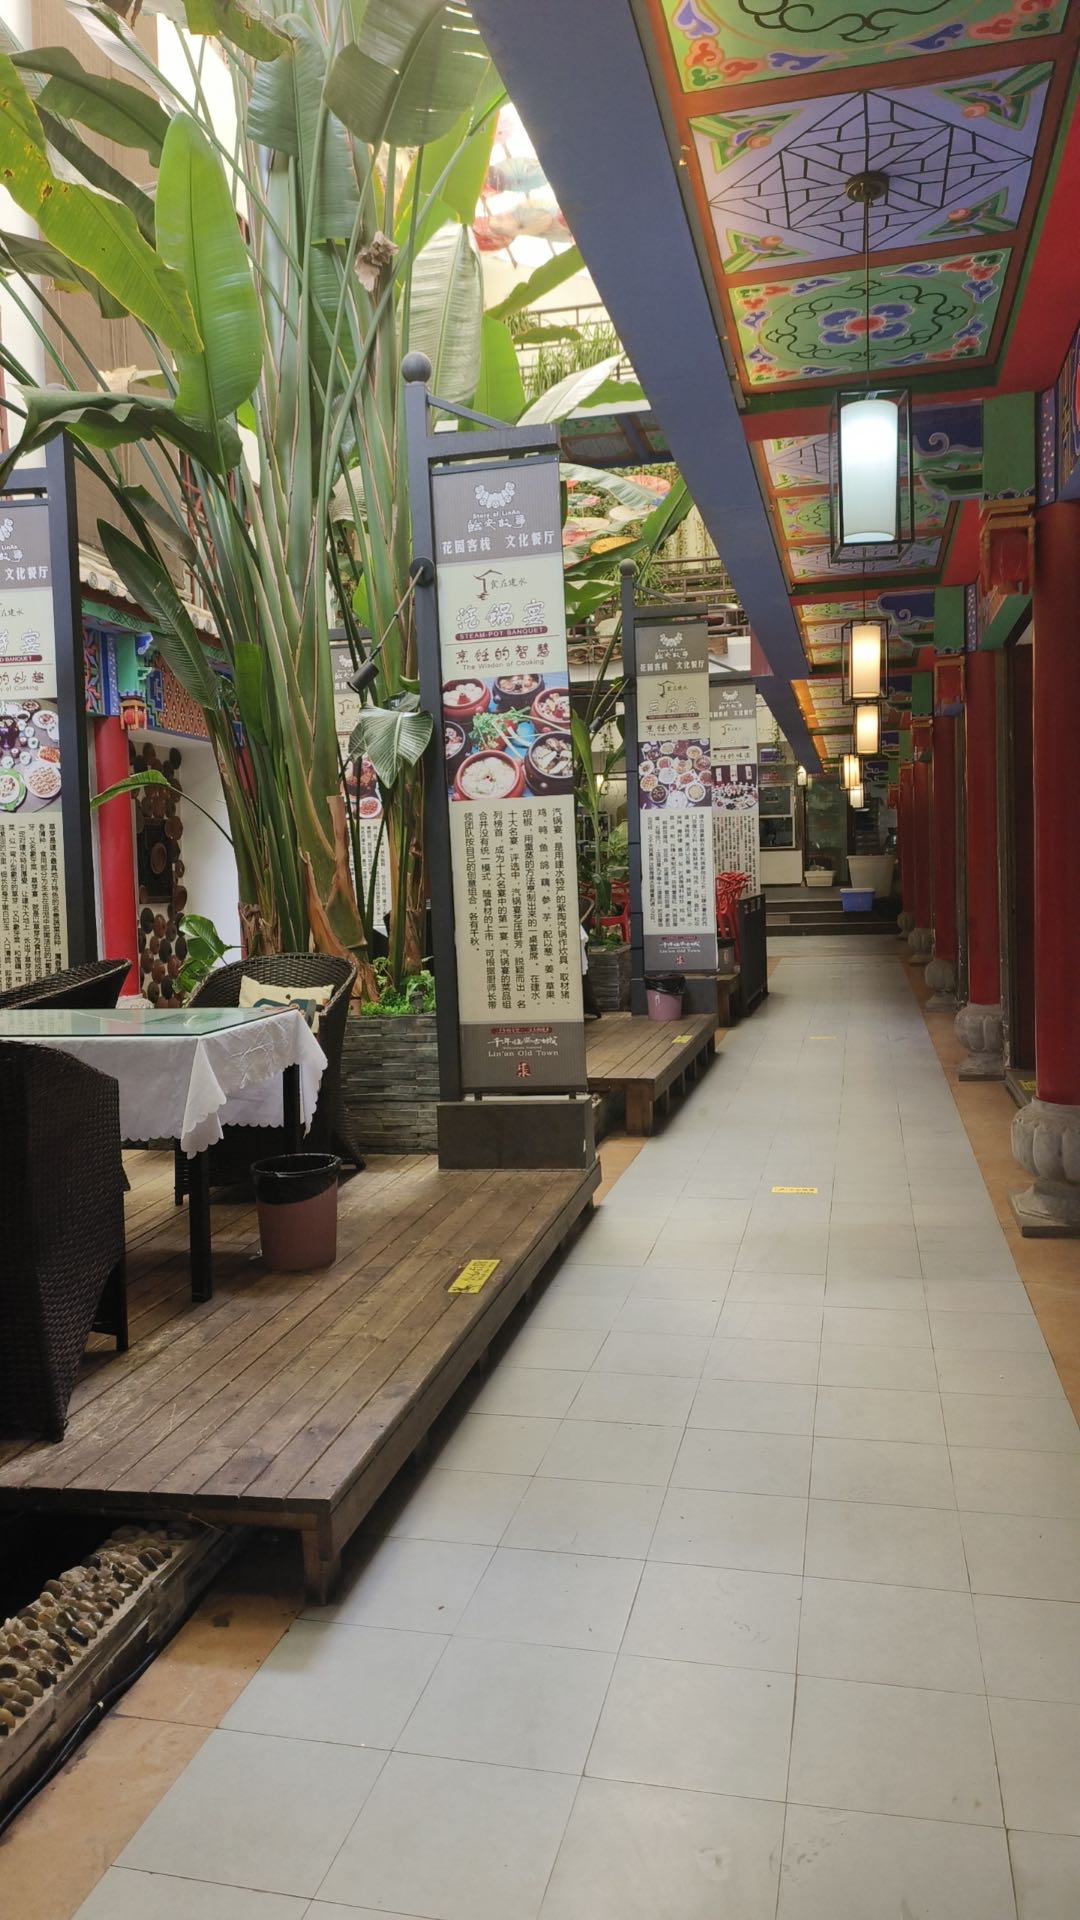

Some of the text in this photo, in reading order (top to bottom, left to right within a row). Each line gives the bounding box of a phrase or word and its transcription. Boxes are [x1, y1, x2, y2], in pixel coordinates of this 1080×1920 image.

[441, 530, 555, 555] 花园客栈 文化餐厅
[5, 565, 49, 580] 文化餐厅
[456, 599, 545, 630] 汽锅宴
[507, 627, 544, 636] BANQUET
[456, 642, 550, 664] 烹饪的智慧
[517, 1049, 533, 1057] Old
